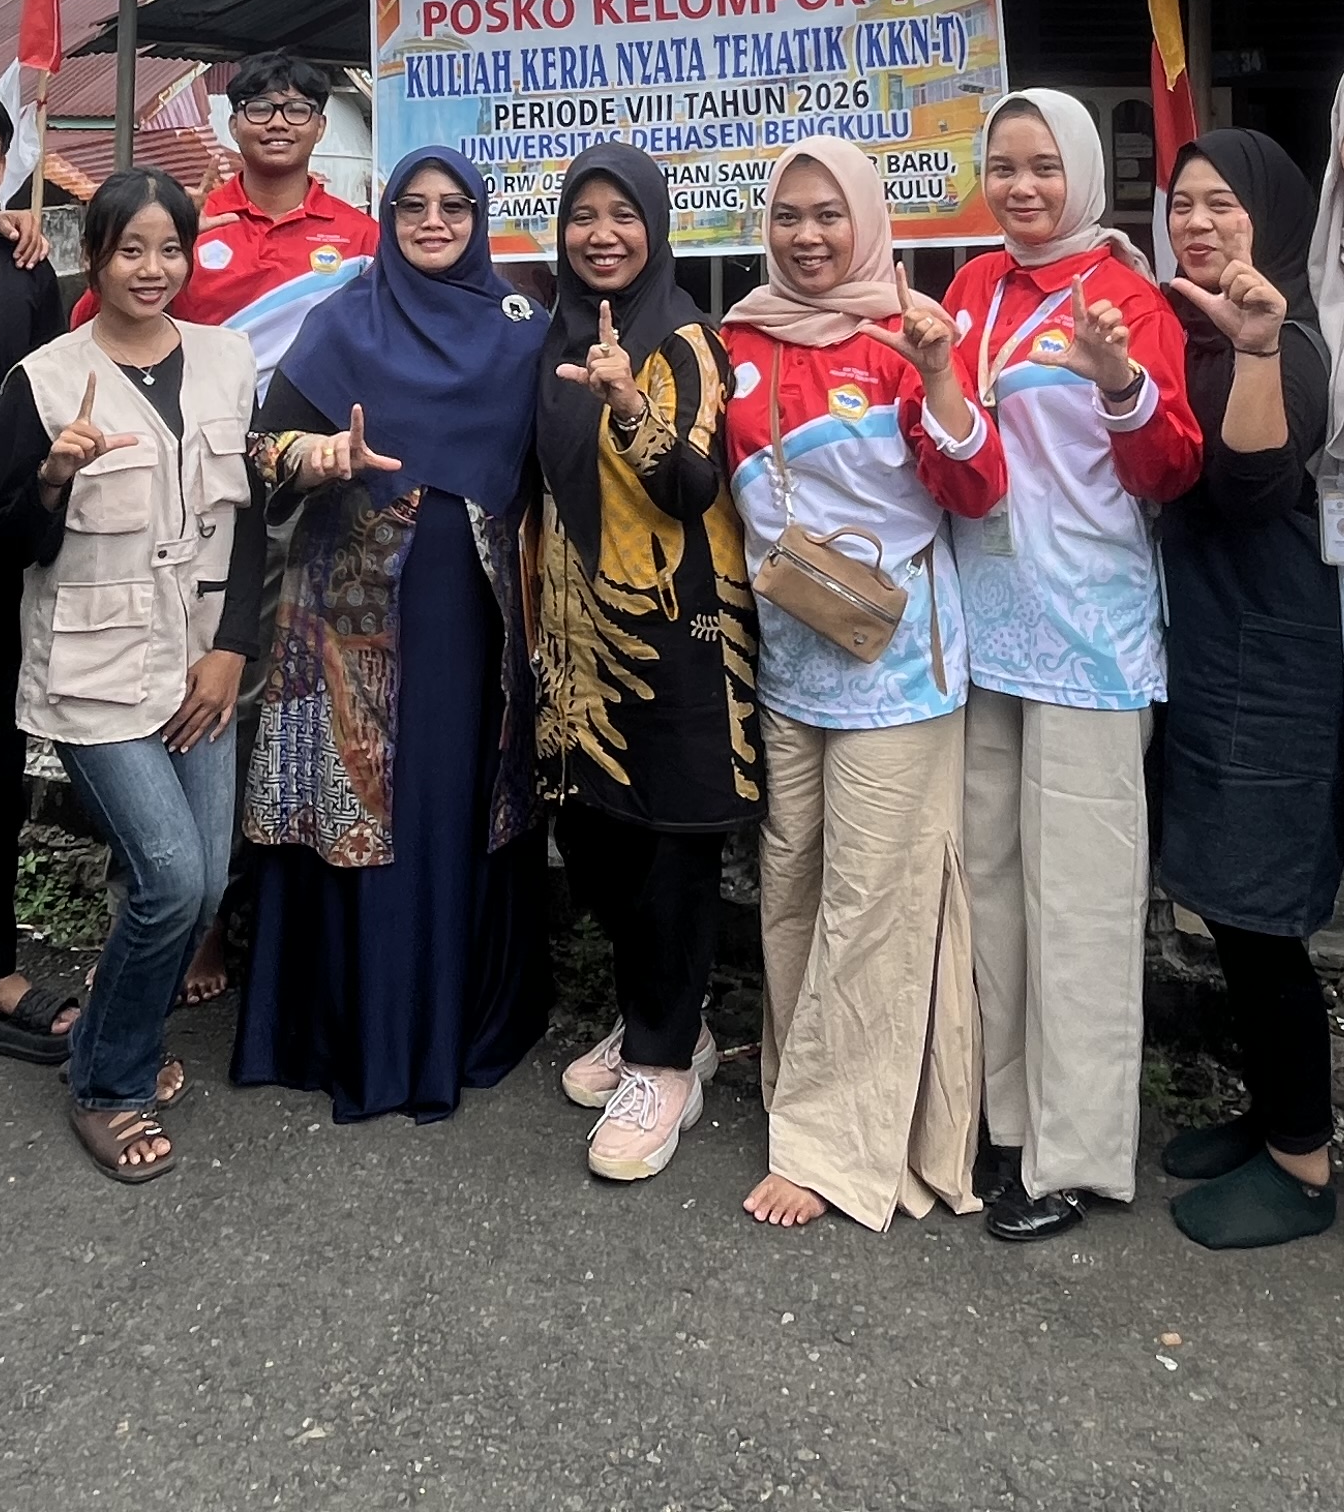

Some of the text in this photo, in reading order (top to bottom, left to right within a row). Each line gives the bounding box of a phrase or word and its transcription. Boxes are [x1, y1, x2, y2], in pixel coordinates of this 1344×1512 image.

[406, 15, 966, 98] KULIAH KERJA NYATA TEMATIK (KKN-T)
[494, 80, 869, 130] PERIODE VIII TAHUN 2026
[631, 122, 754, 152] DEHASEN
[765, 112, 908, 145] BENGKULU
[504, 174, 536, 193] RW
[886, 151, 956, 173] BARU,
[671, 188, 744, 210] GUNG,
